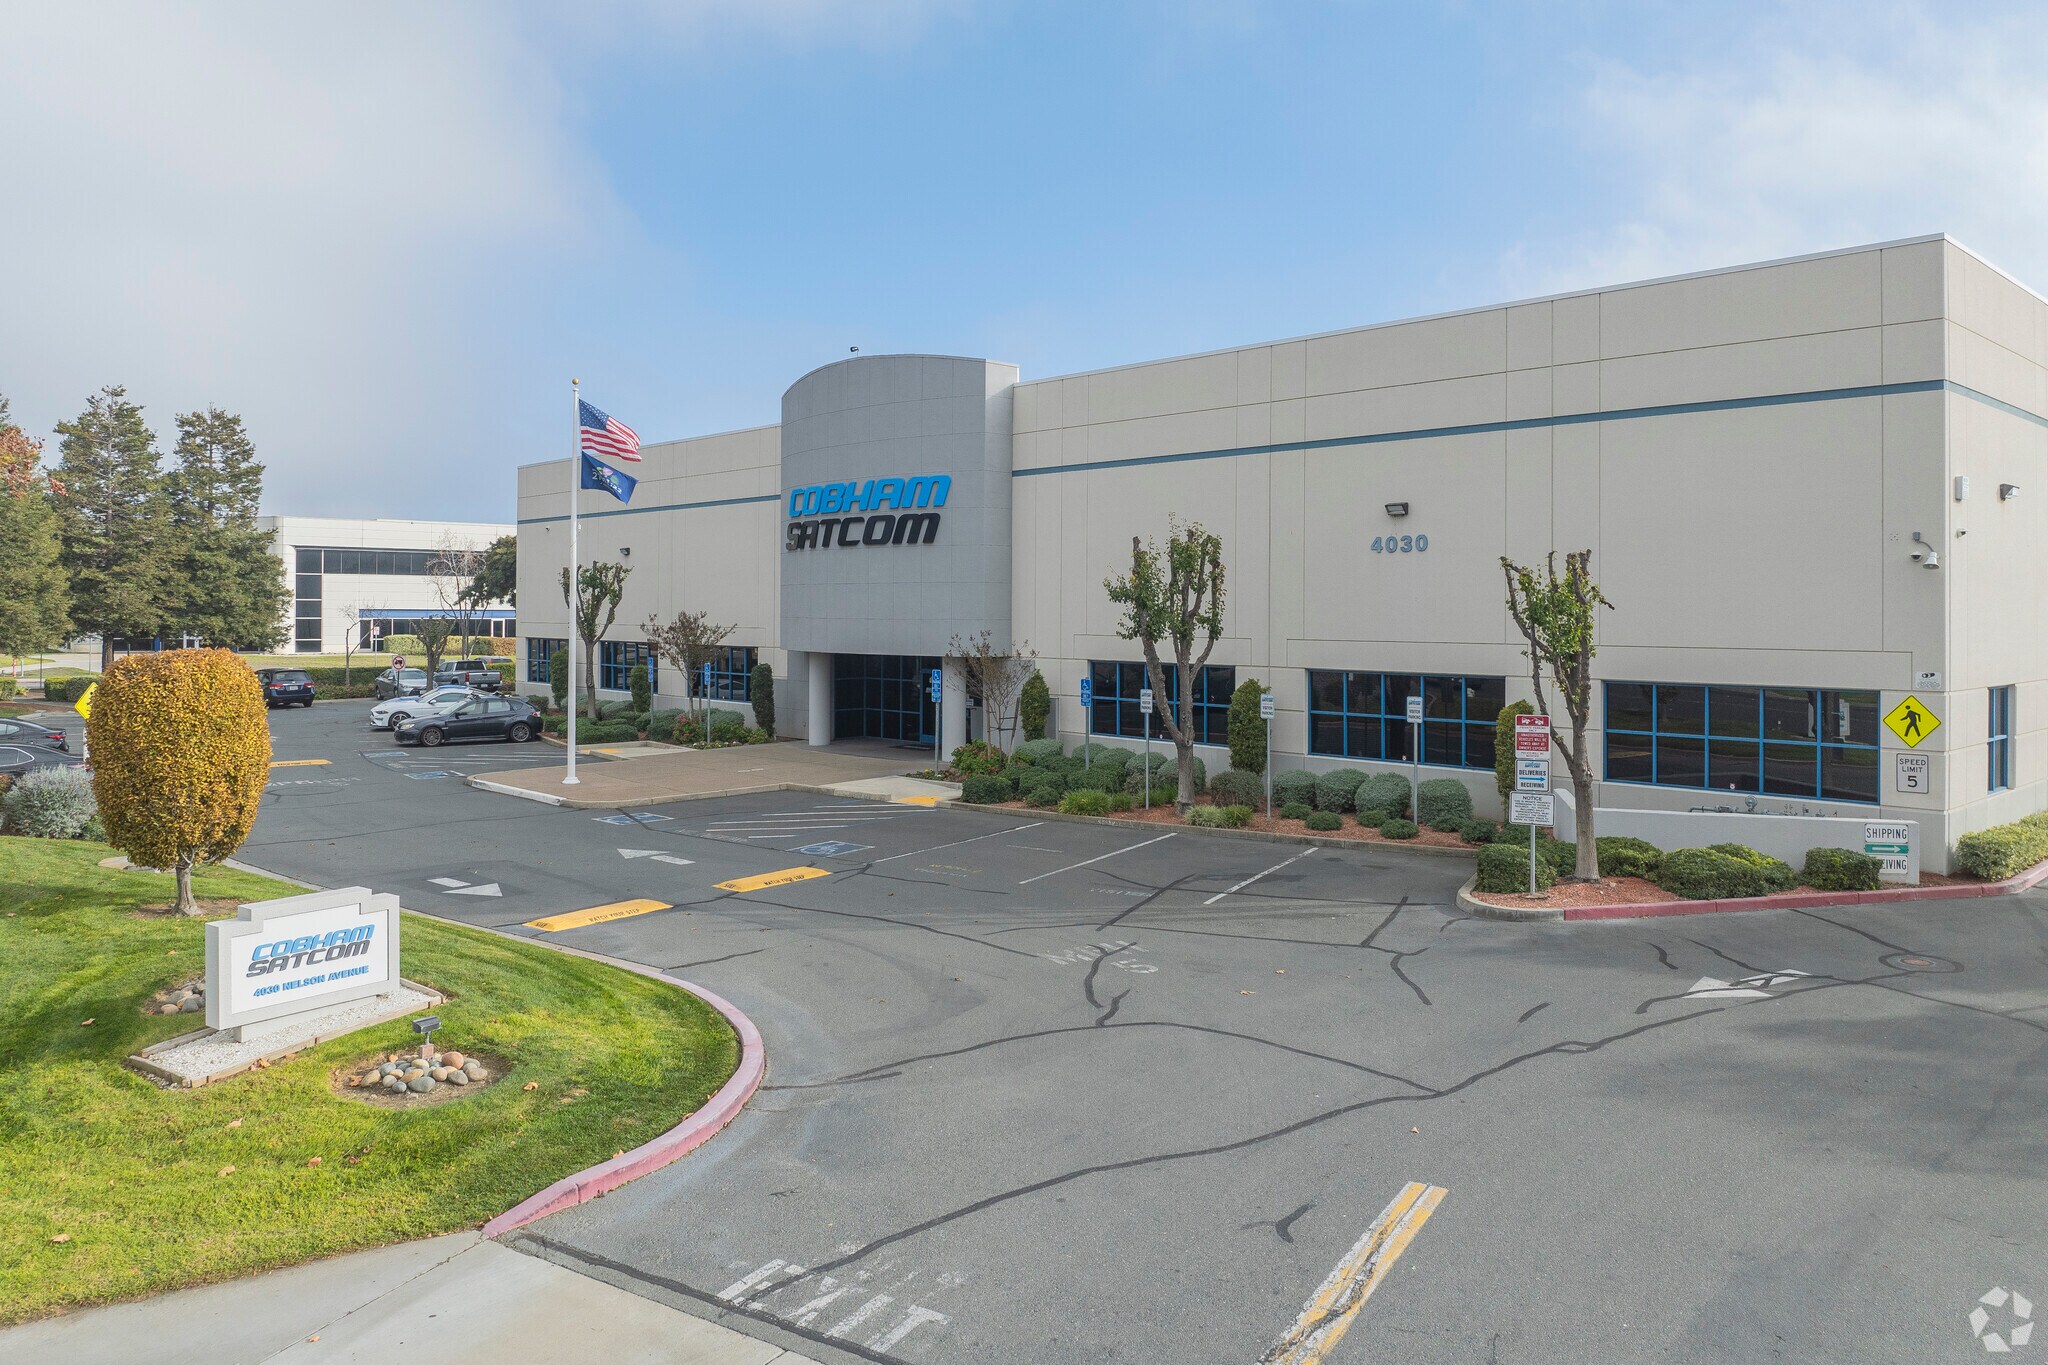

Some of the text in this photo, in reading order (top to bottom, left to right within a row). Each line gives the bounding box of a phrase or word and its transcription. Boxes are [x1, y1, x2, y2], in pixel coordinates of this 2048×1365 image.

[788, 475, 952, 518] COBHAM
[785, 512, 941, 551] SATCOM
[1370, 534, 1429, 554] 4030
[1899, 758, 1927, 766] SPEED
[1518, 769, 1547, 777] DELIVERIES
[1907, 775, 1918, 788] 5
[1866, 827, 1907, 840] SHIPPING
[1881, 859, 1907, 870] EIVING
[588, 914, 609, 922] WATCH
[251, 924, 375, 961] COBHAM
[246, 939, 371, 978] SATCOM
[253, 965, 369, 997] 4030 NELSON AVENUE
